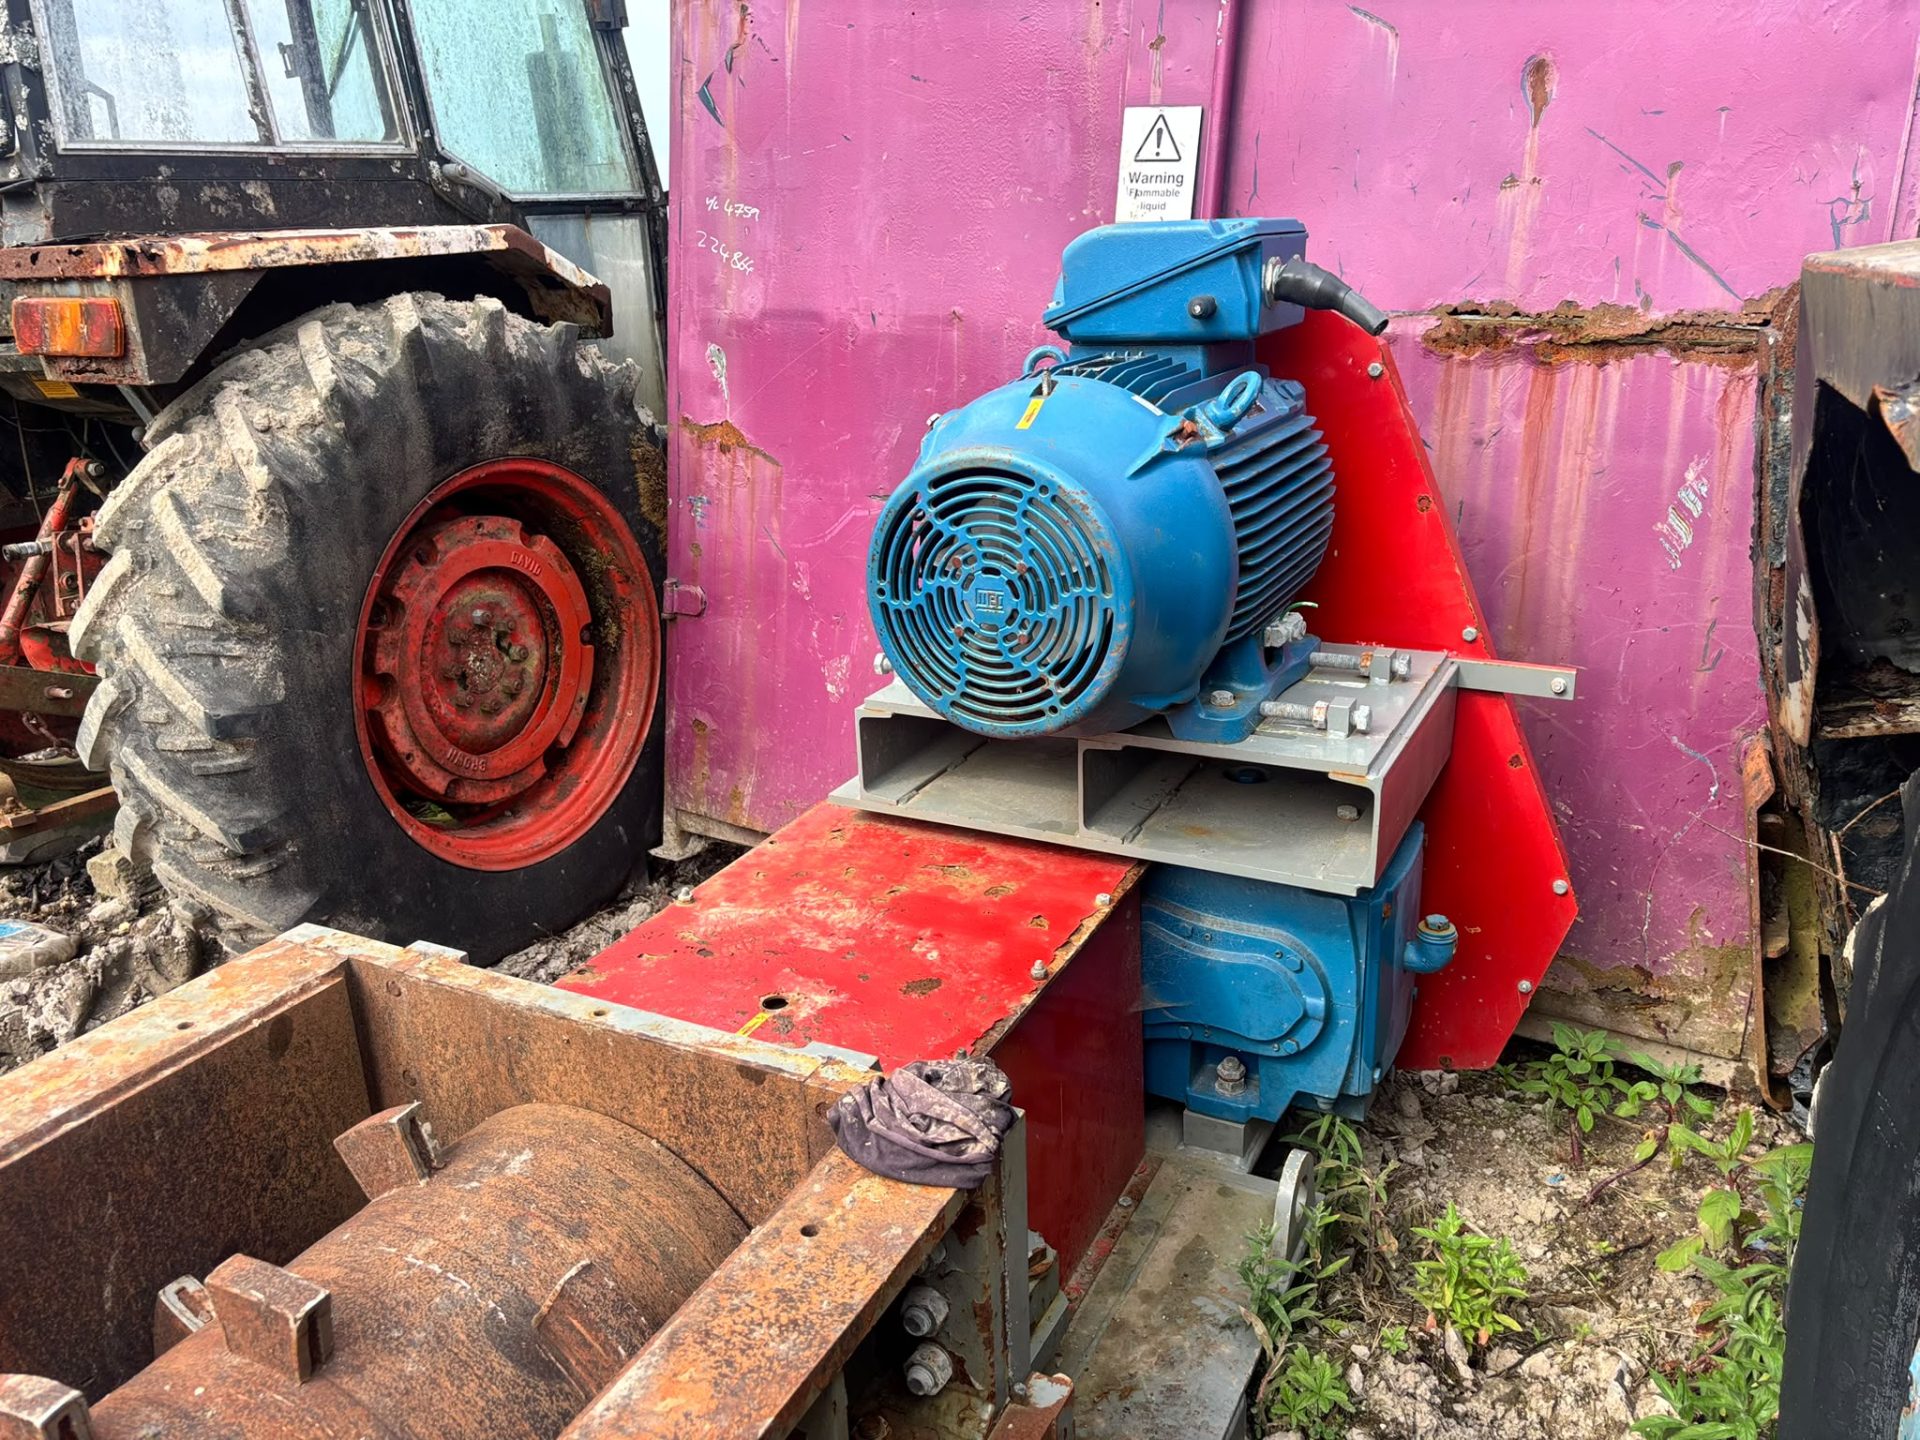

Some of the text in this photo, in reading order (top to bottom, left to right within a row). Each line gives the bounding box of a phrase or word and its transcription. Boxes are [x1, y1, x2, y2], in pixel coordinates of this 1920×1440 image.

[1129, 171, 1184, 187] Warning
[723, 198, 761, 222] 4759
[1140, 202, 1167, 212] liquid
[511, 550, 542, 575] DAVID
[447, 747, 486, 772] BROWN
